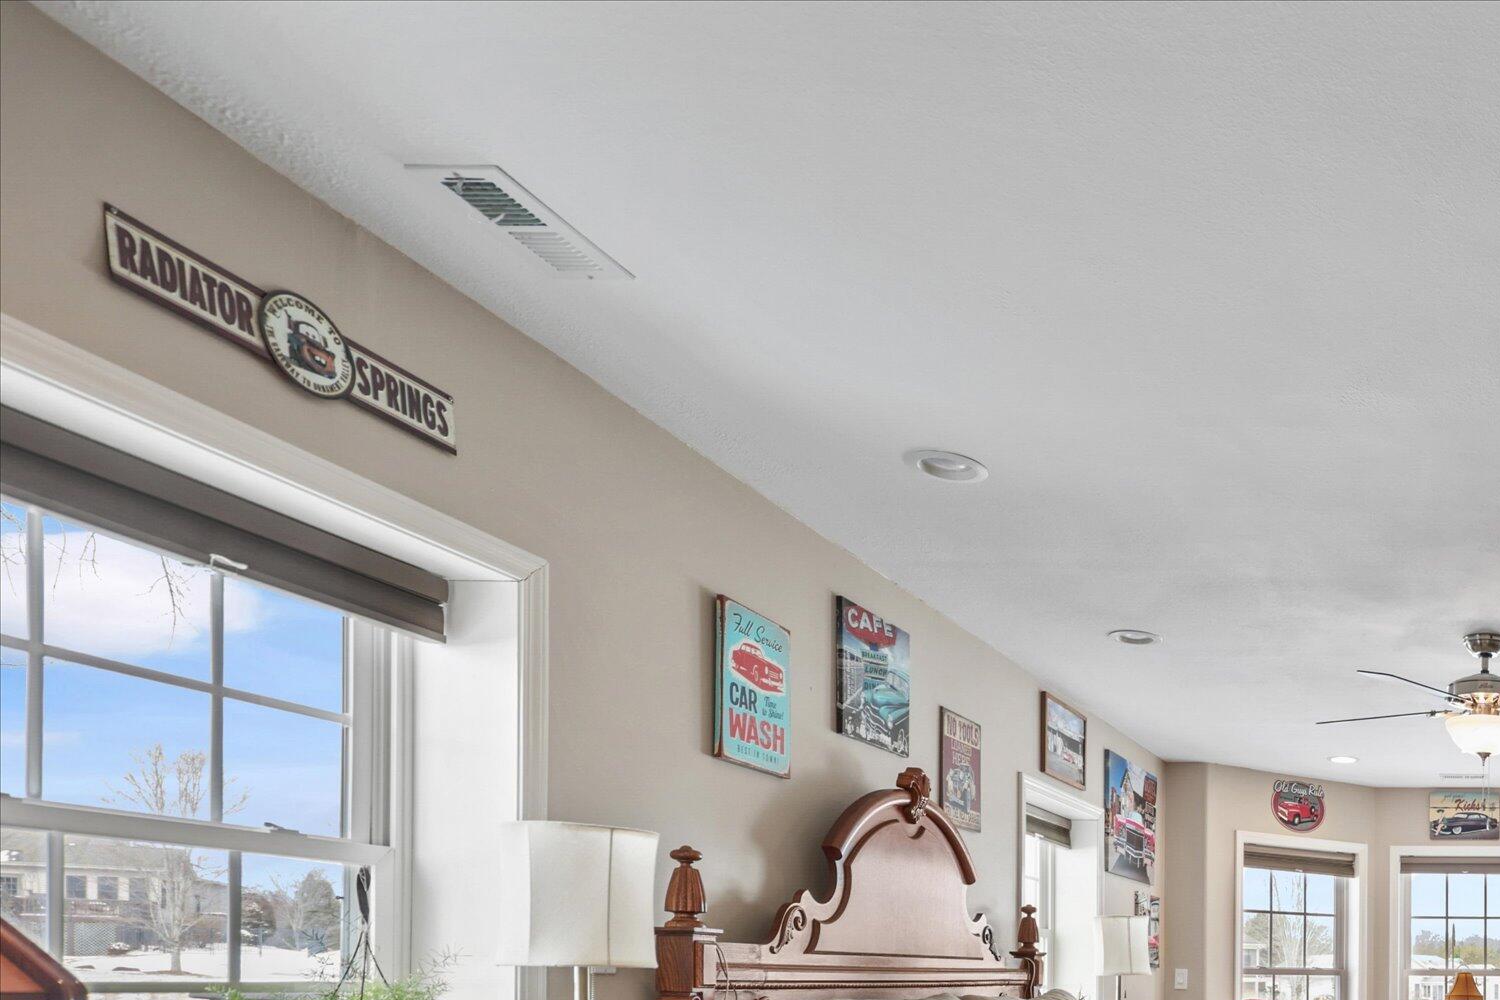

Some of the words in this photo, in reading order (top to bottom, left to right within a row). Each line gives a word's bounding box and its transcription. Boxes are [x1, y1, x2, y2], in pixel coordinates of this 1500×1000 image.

[115, 223, 255, 338] RADIATOR
[266, 297, 325, 325] WELCOME
[328, 327, 341, 346] TO
[355, 356, 449, 438] SPRINGS
[732, 612, 754, 639] Full
[754, 625, 783, 653] Service
[847, 606, 894, 638] CAFE
[729, 681, 758, 714] CAR
[728, 707, 785, 756] WASH
[1273, 779, 1289, 793] Old
